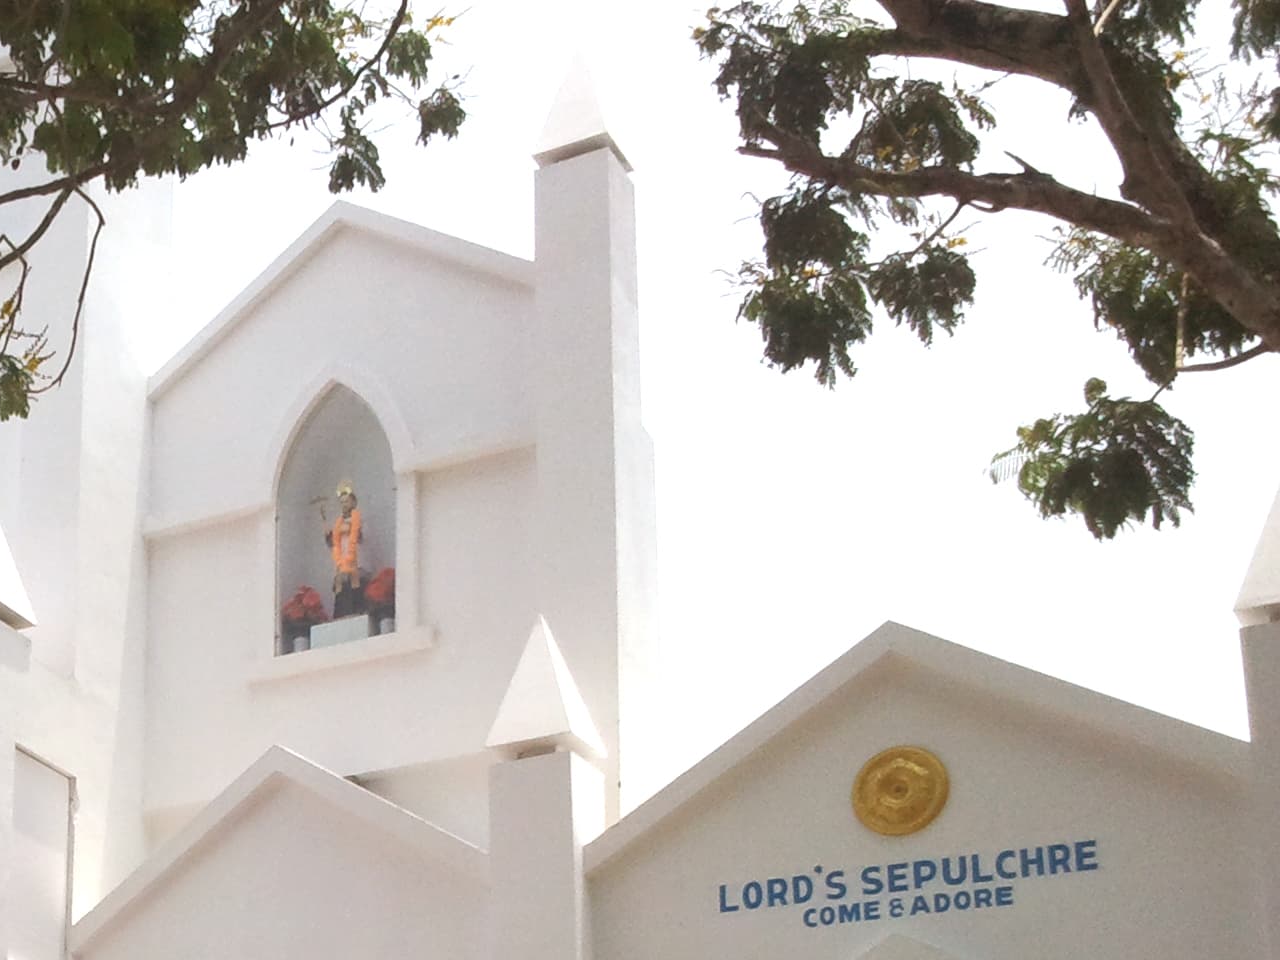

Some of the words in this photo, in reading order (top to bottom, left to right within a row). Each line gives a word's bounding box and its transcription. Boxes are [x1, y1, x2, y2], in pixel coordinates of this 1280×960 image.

[718, 864, 848, 914] LORD'S
[860, 839, 1099, 896] SEPULCHRE
[802, 899, 881, 928] COME
